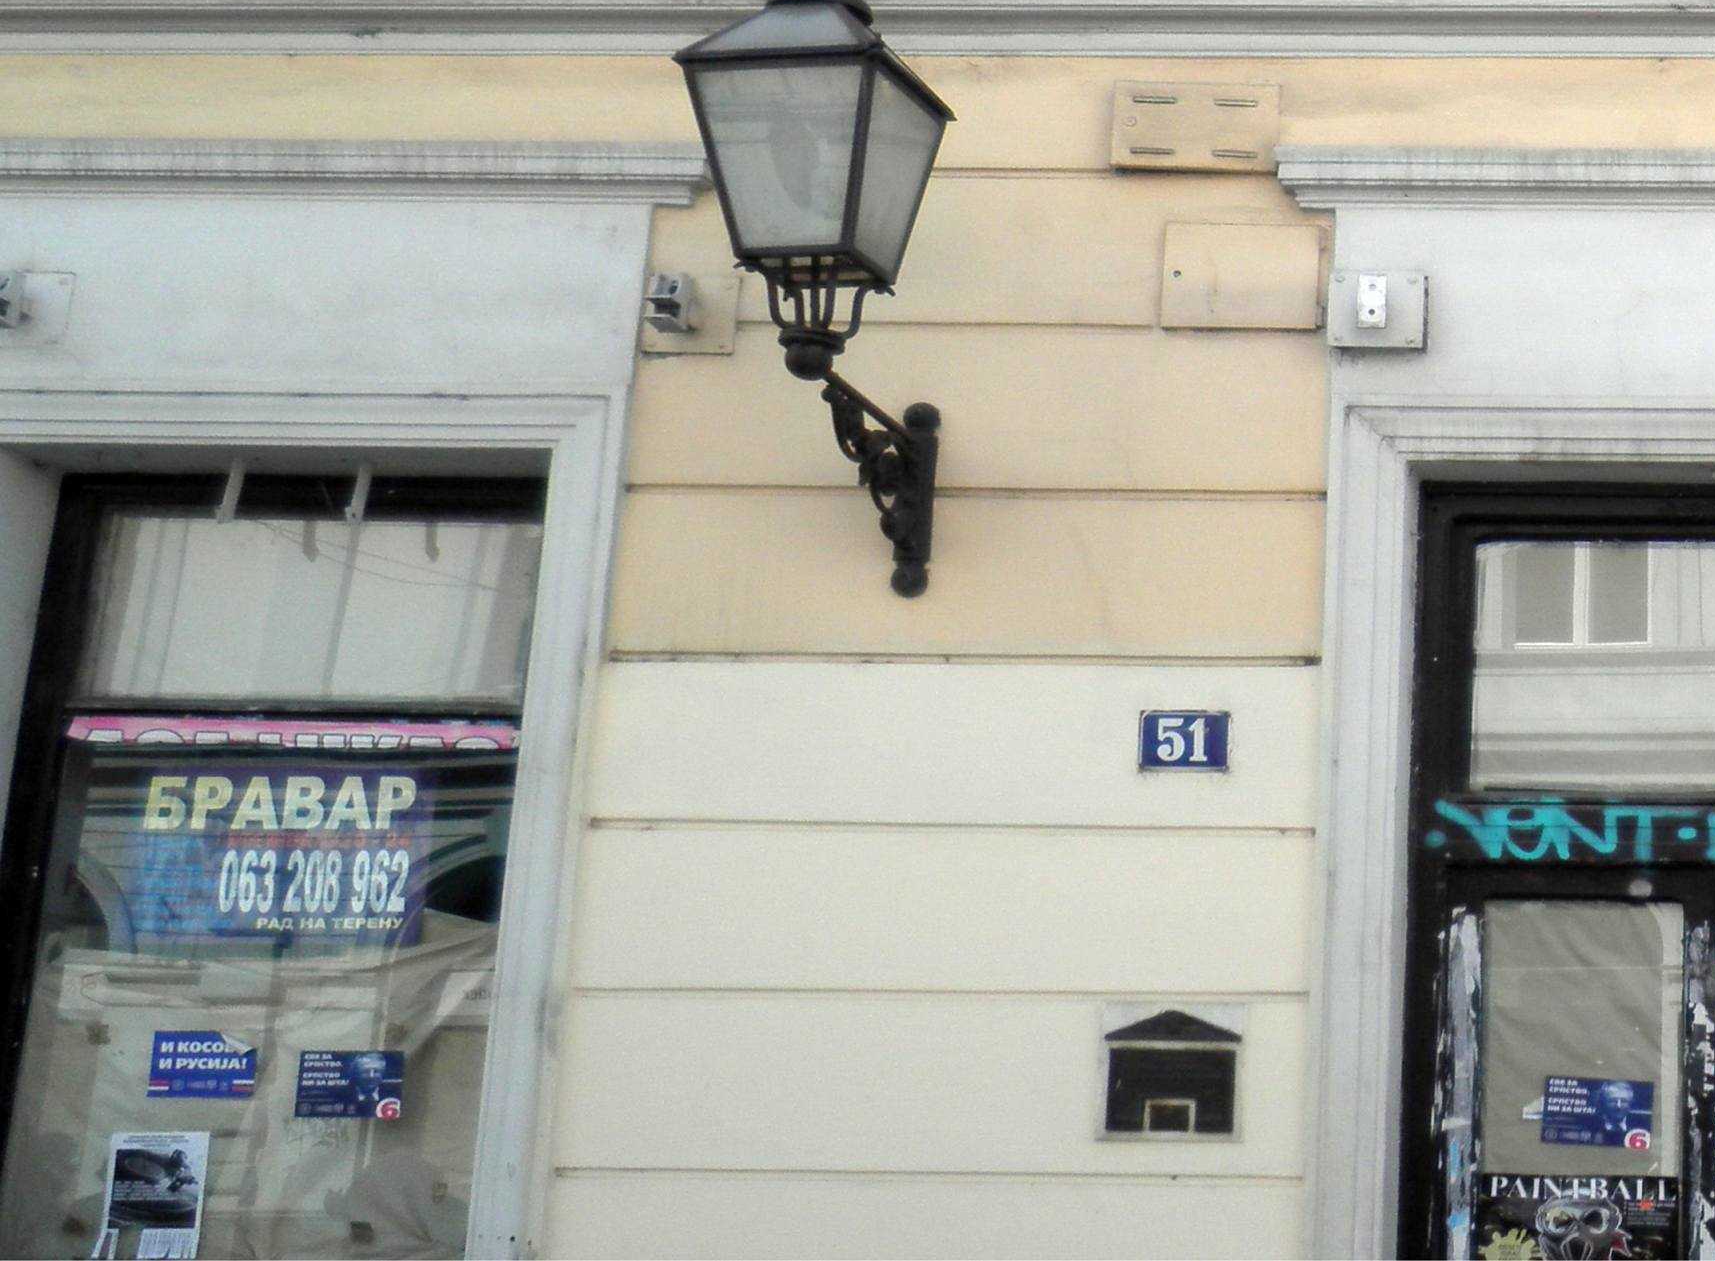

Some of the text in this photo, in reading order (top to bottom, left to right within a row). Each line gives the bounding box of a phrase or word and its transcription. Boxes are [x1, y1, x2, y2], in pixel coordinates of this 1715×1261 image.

[1155, 717, 1209, 763] 51
[143, 776, 417, 831] БРАВАР
[218, 849, 277, 913] 063
[282, 849, 342, 913] 208
[351, 849, 410, 913] 962
[256, 917, 404, 931] РАД НА ТЕРЕНУ
[161, 1041, 234, 1053] И КОСО
[159, 1058, 247, 1070] И РУСИЈА!
[1490, 1176, 1678, 1201] PAINTBALL
